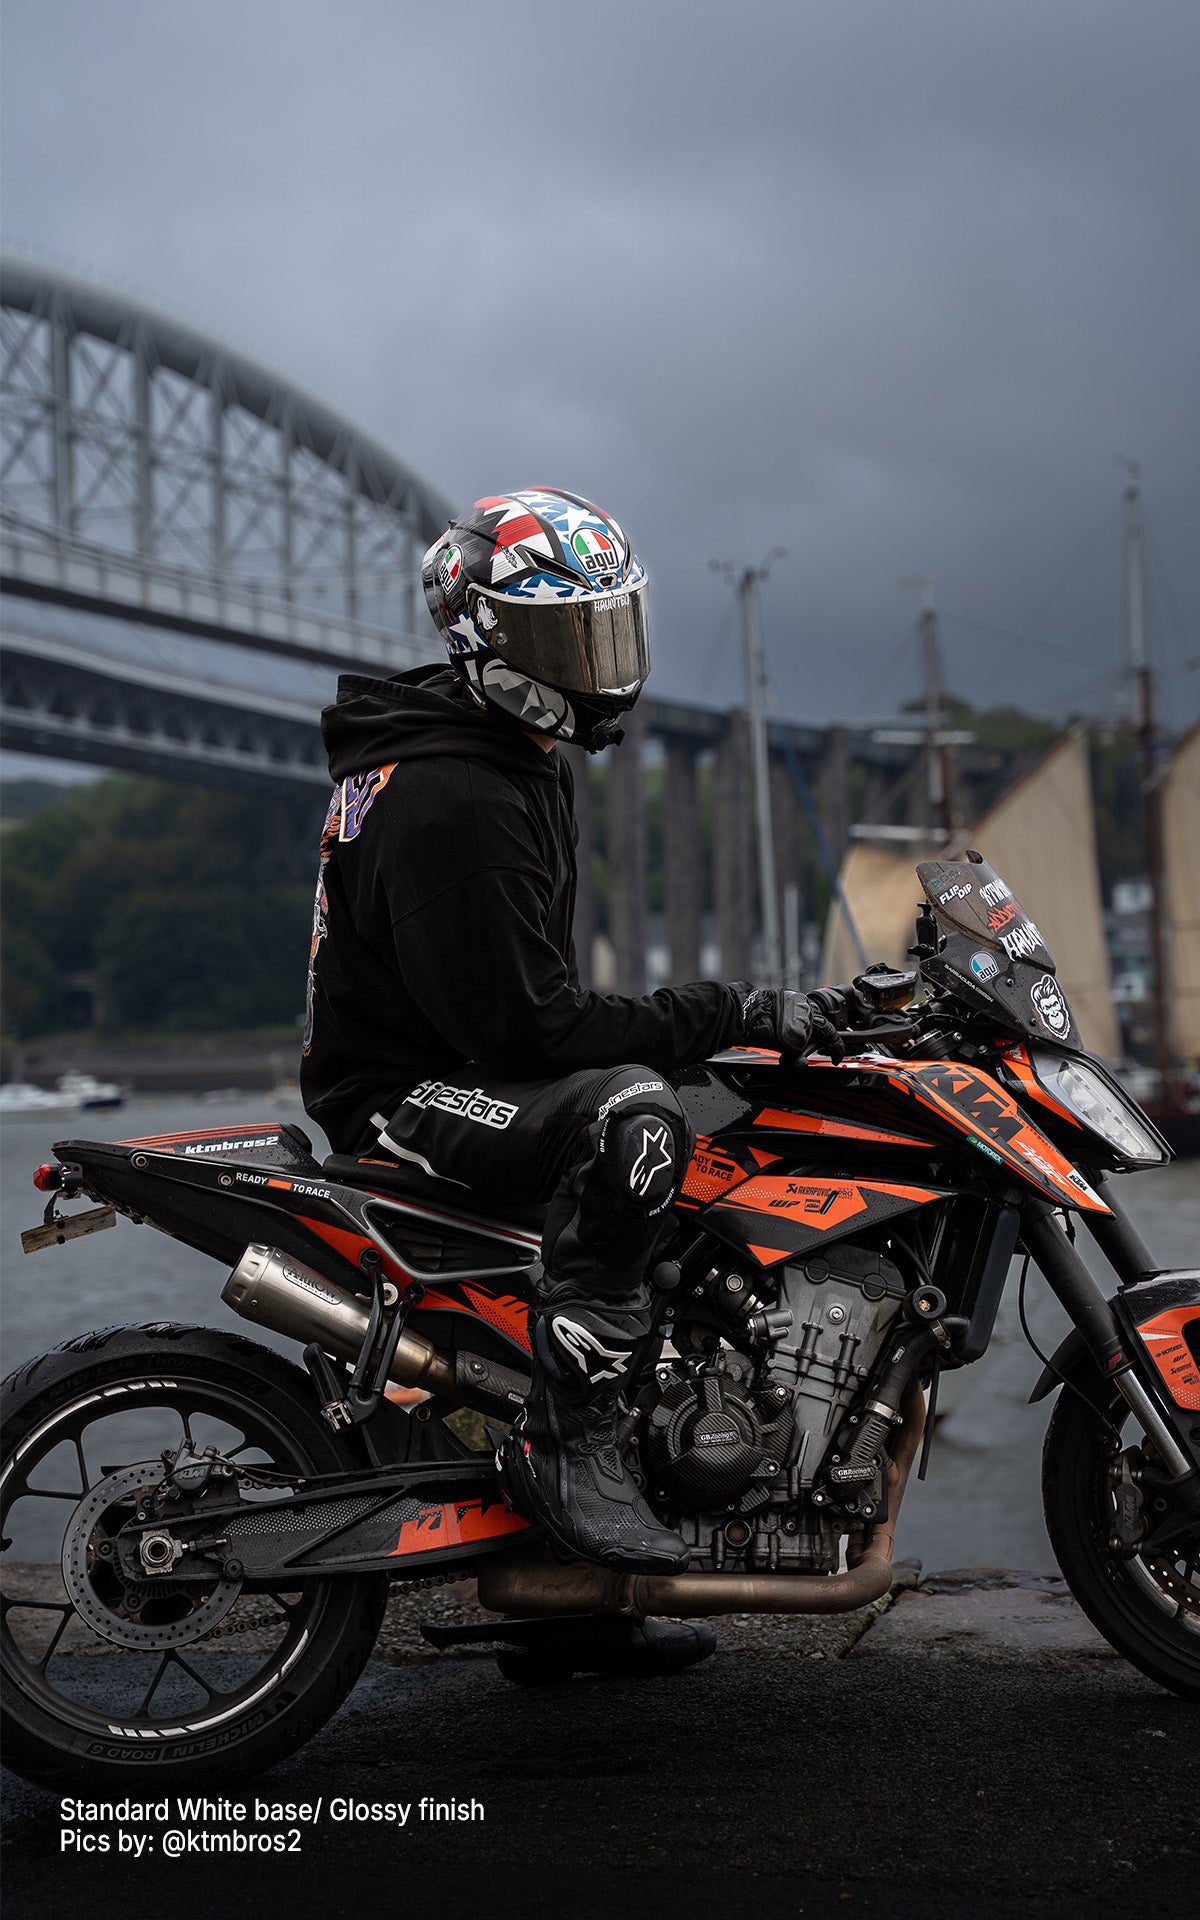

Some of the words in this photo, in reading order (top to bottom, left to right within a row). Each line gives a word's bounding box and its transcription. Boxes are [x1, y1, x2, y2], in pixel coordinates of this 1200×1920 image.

[584, 551, 615, 571] agv
[939, 884, 960, 905] FLIP
[957, 882, 973, 900] DIP
[915, 1064, 1026, 1143] KTM
[185, 1136, 280, 1154] ktmbros2
[977, 1141, 1004, 1165] MOTOREX
[696, 1164, 708, 1174] TO
[708, 1167, 734, 1182] RACE
[235, 1172, 268, 1185] READY
[293, 1184, 305, 1194] TO
[305, 1186, 331, 1199] RACE
[172, 1713, 264, 1758] MICHELIN
[106, 1748, 157, 1761] ROAD
